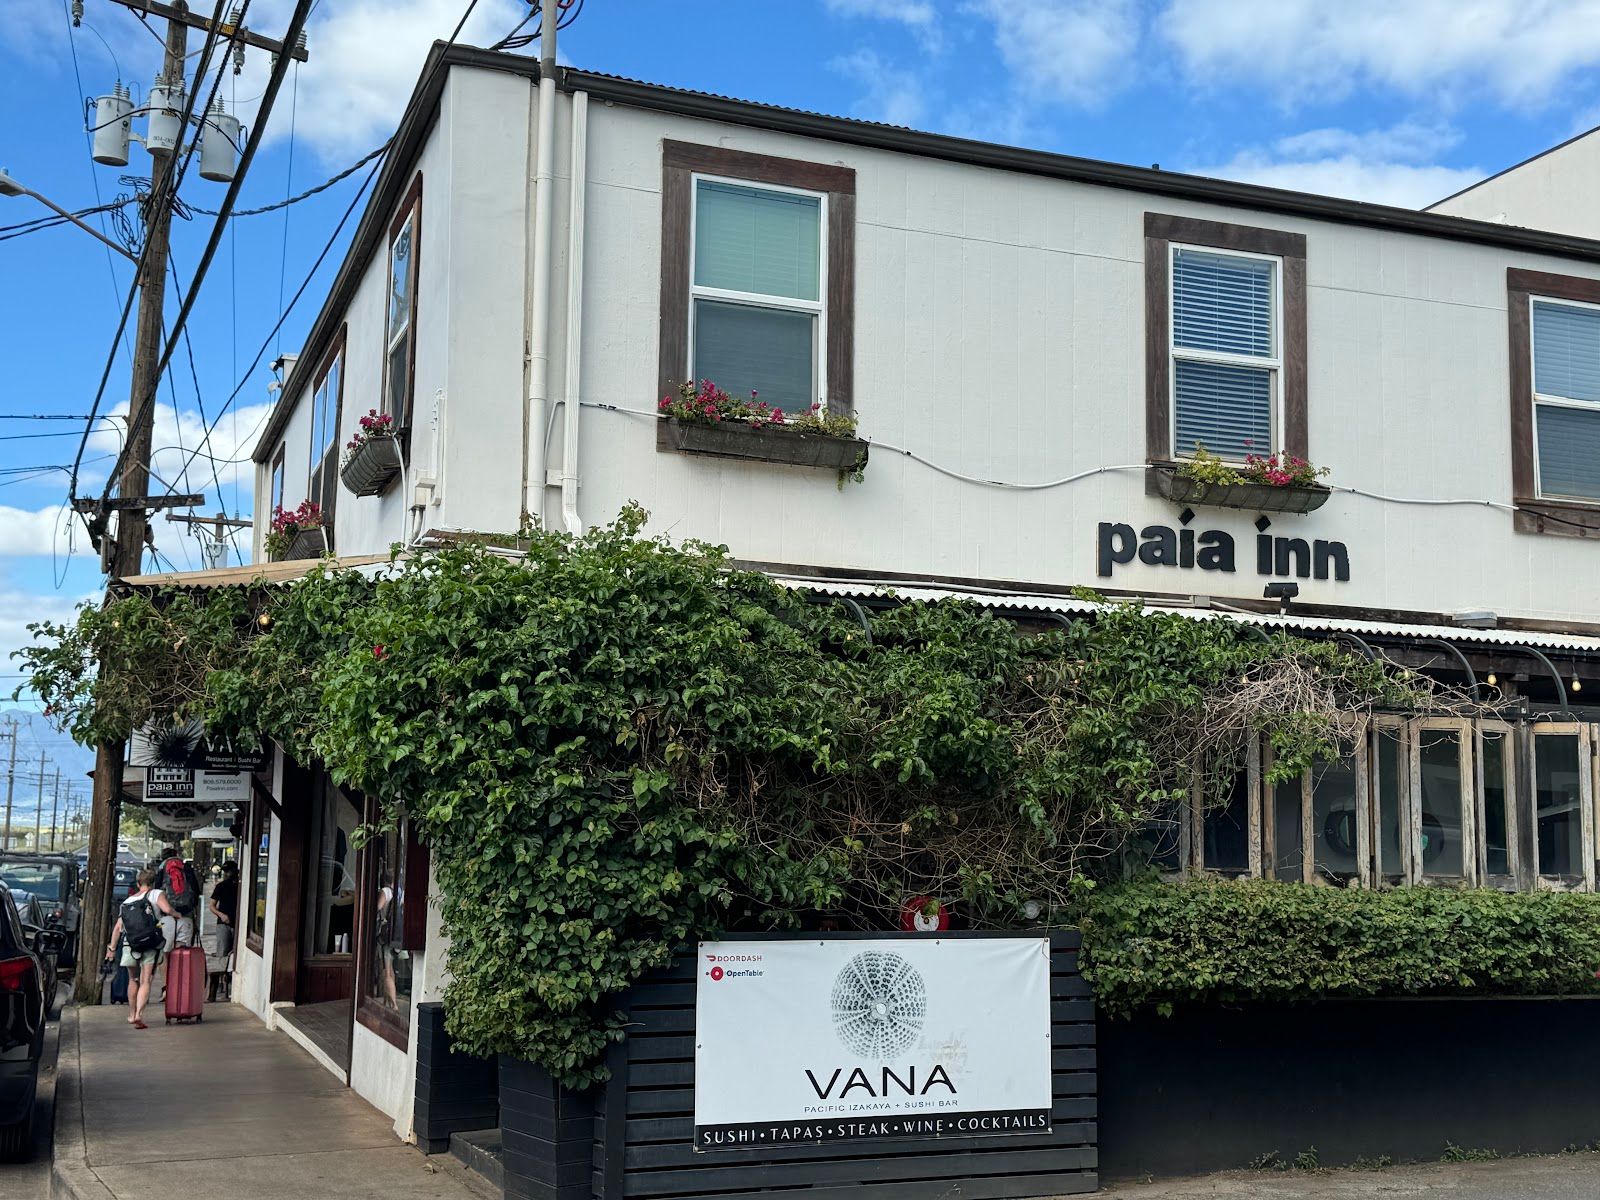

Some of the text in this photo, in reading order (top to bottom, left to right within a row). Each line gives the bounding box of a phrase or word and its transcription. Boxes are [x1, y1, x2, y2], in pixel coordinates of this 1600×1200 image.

[1096, 507, 1350, 582] paia inn
[205, 734, 264, 754] VAA
[205, 755, 233, 763] Restaurant
[147, 783, 173, 796] paia
[726, 969, 763, 978] OpenTable
[804, 1064, 957, 1099] VANA
[804, 1104, 845, 1113] PACIFIC
[849, 1103, 891, 1111] IZAKAYA
[703, 1114, 1046, 1144] SUSHI TAPAS STEAK WINE COCKTAILS
